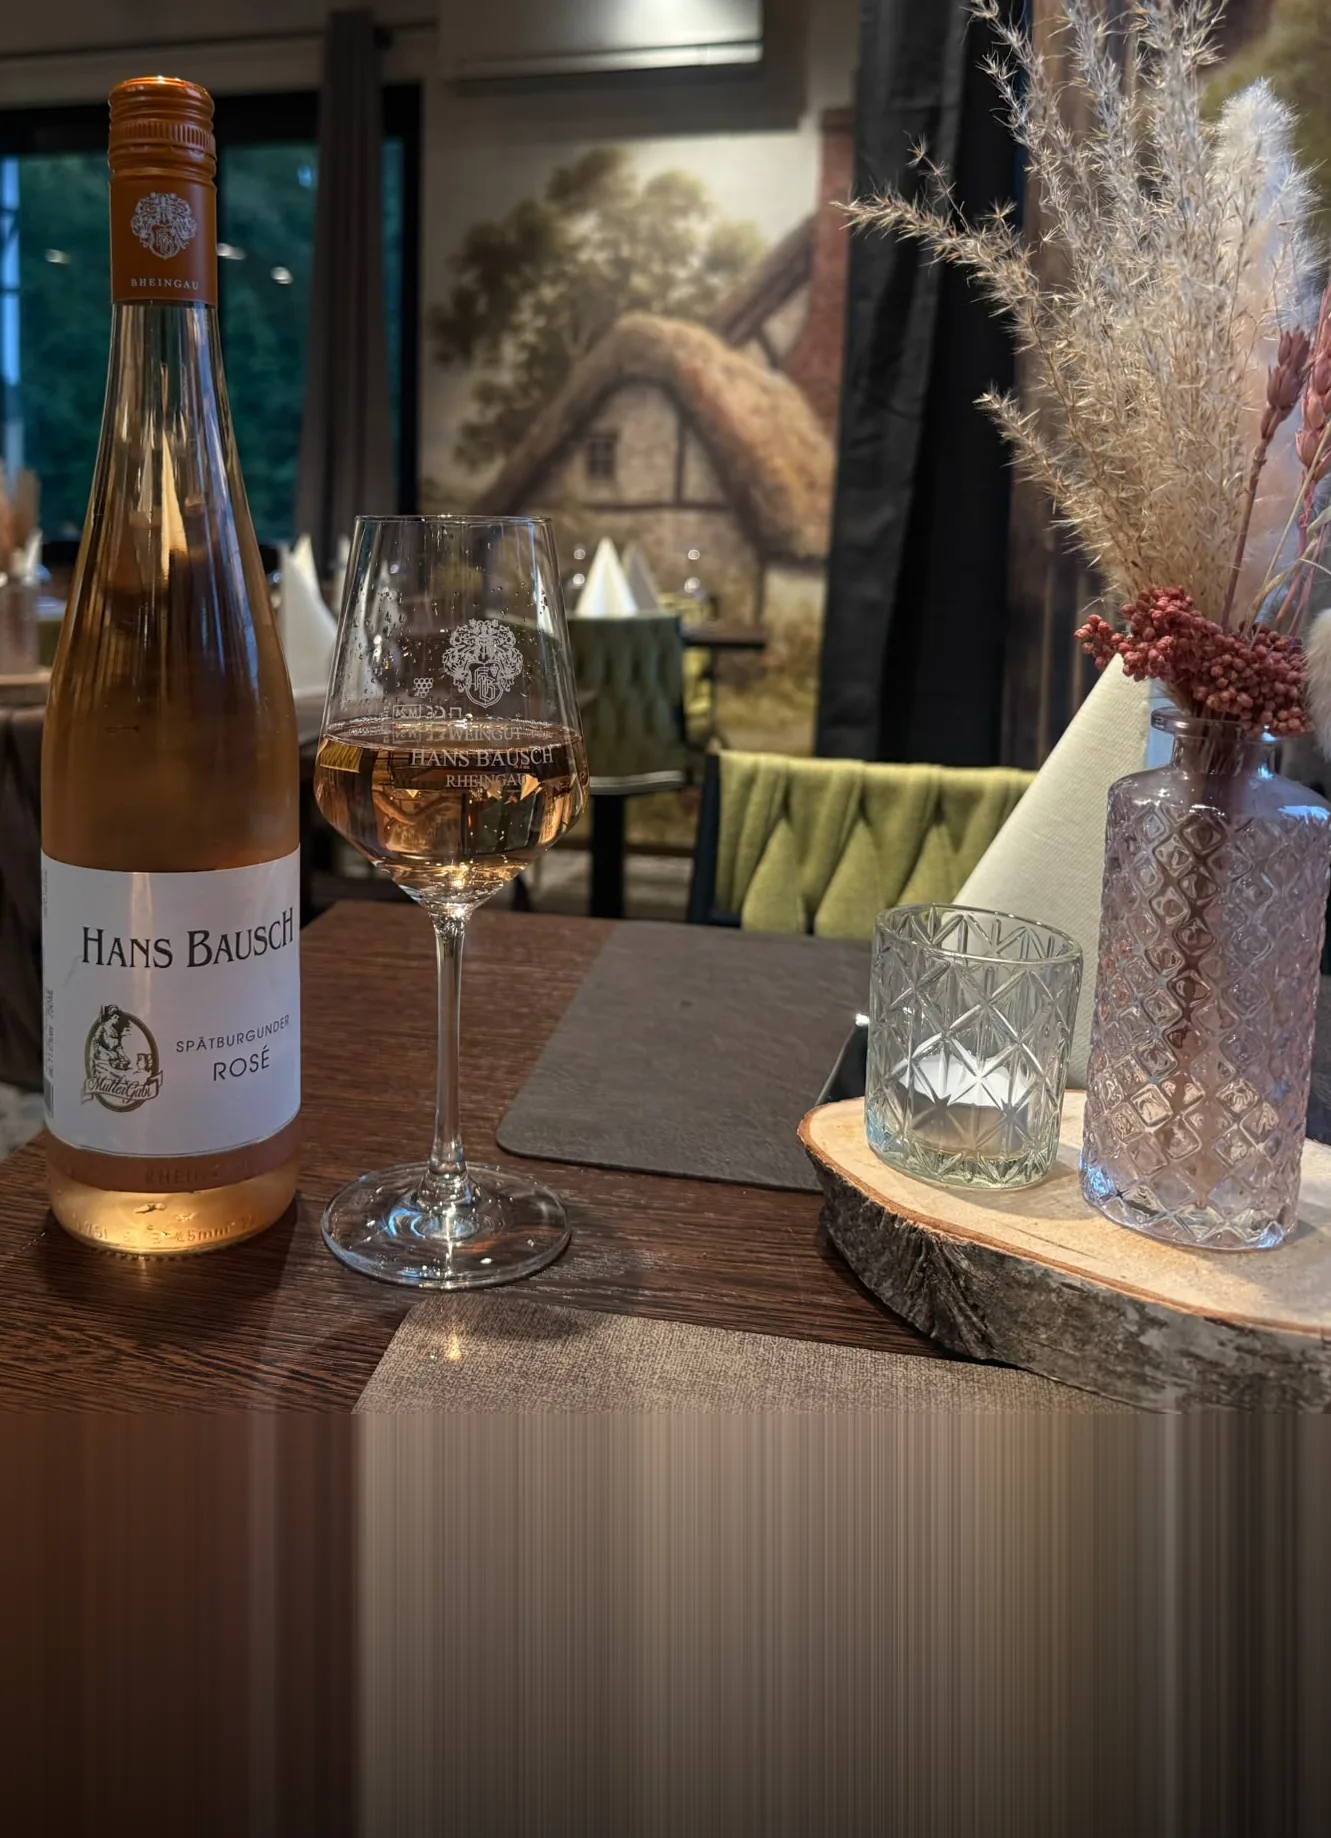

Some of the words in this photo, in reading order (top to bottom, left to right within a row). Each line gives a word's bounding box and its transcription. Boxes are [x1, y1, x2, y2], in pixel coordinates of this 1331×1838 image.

[131, 278, 199, 290] RHEINGAU
[450, 726, 523, 742] WEINGUT
[410, 748, 470, 768] HANS
[475, 746, 554, 768] BAUSCH
[445, 773, 528, 788] RHEINGAU
[82, 926, 173, 968] HANS
[187, 907, 293, 967] BAUSCH
[176, 1015, 289, 1052] SPÄTBURGUNDER
[213, 1044, 270, 1081] ROSÉ
